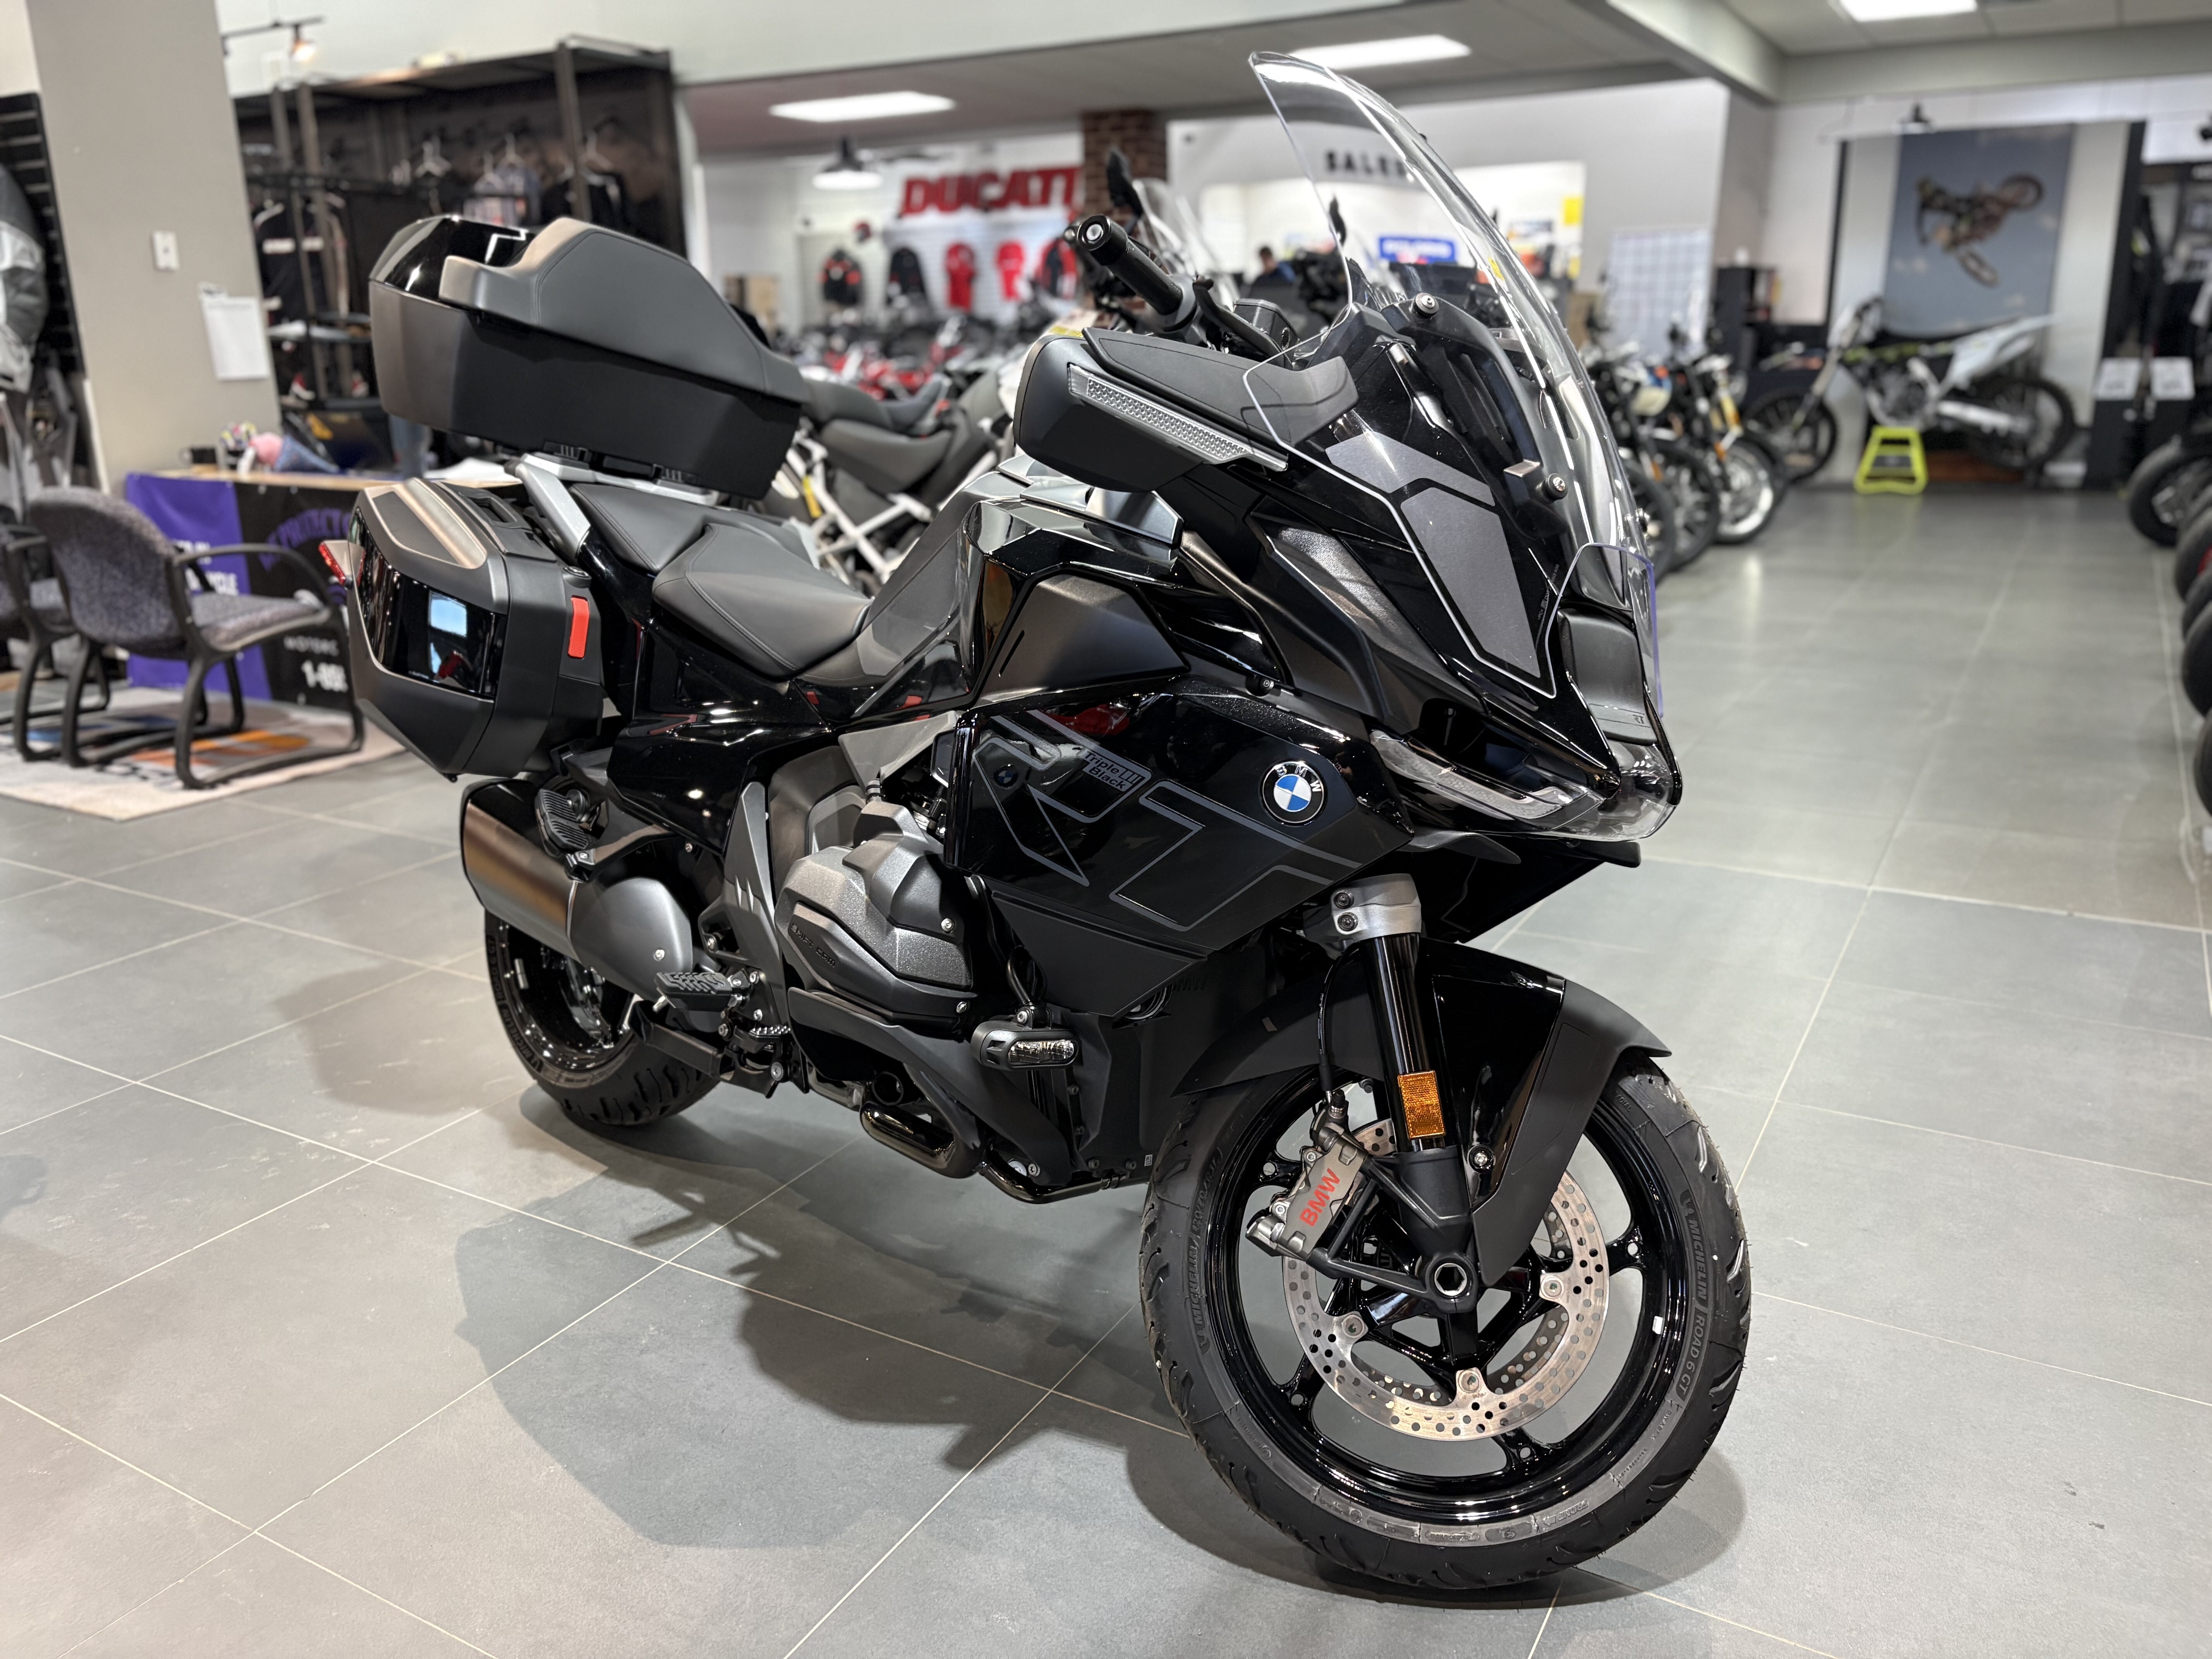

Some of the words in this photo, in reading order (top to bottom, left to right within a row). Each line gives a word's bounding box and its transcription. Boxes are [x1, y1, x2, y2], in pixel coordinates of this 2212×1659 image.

[898, 167, 1080, 218] DUCATI
[1085, 750, 1120, 774] Triple
[1089, 766, 1126, 790] Black
[1276, 765, 1322, 792] BMW
[503, 1008, 532, 1060] MICHELIN
[1299, 1168, 1341, 1227] BMW
[1688, 1219, 1707, 1300] MICHELIN
[1188, 1245, 1203, 1325] MICHELIN
[1690, 1314, 1705, 1359] ROAD
[1686, 1360, 1695, 1372] 6
[1679, 1374, 1691, 1395] GT
[1556, 1499, 1589, 1521] FRONT
